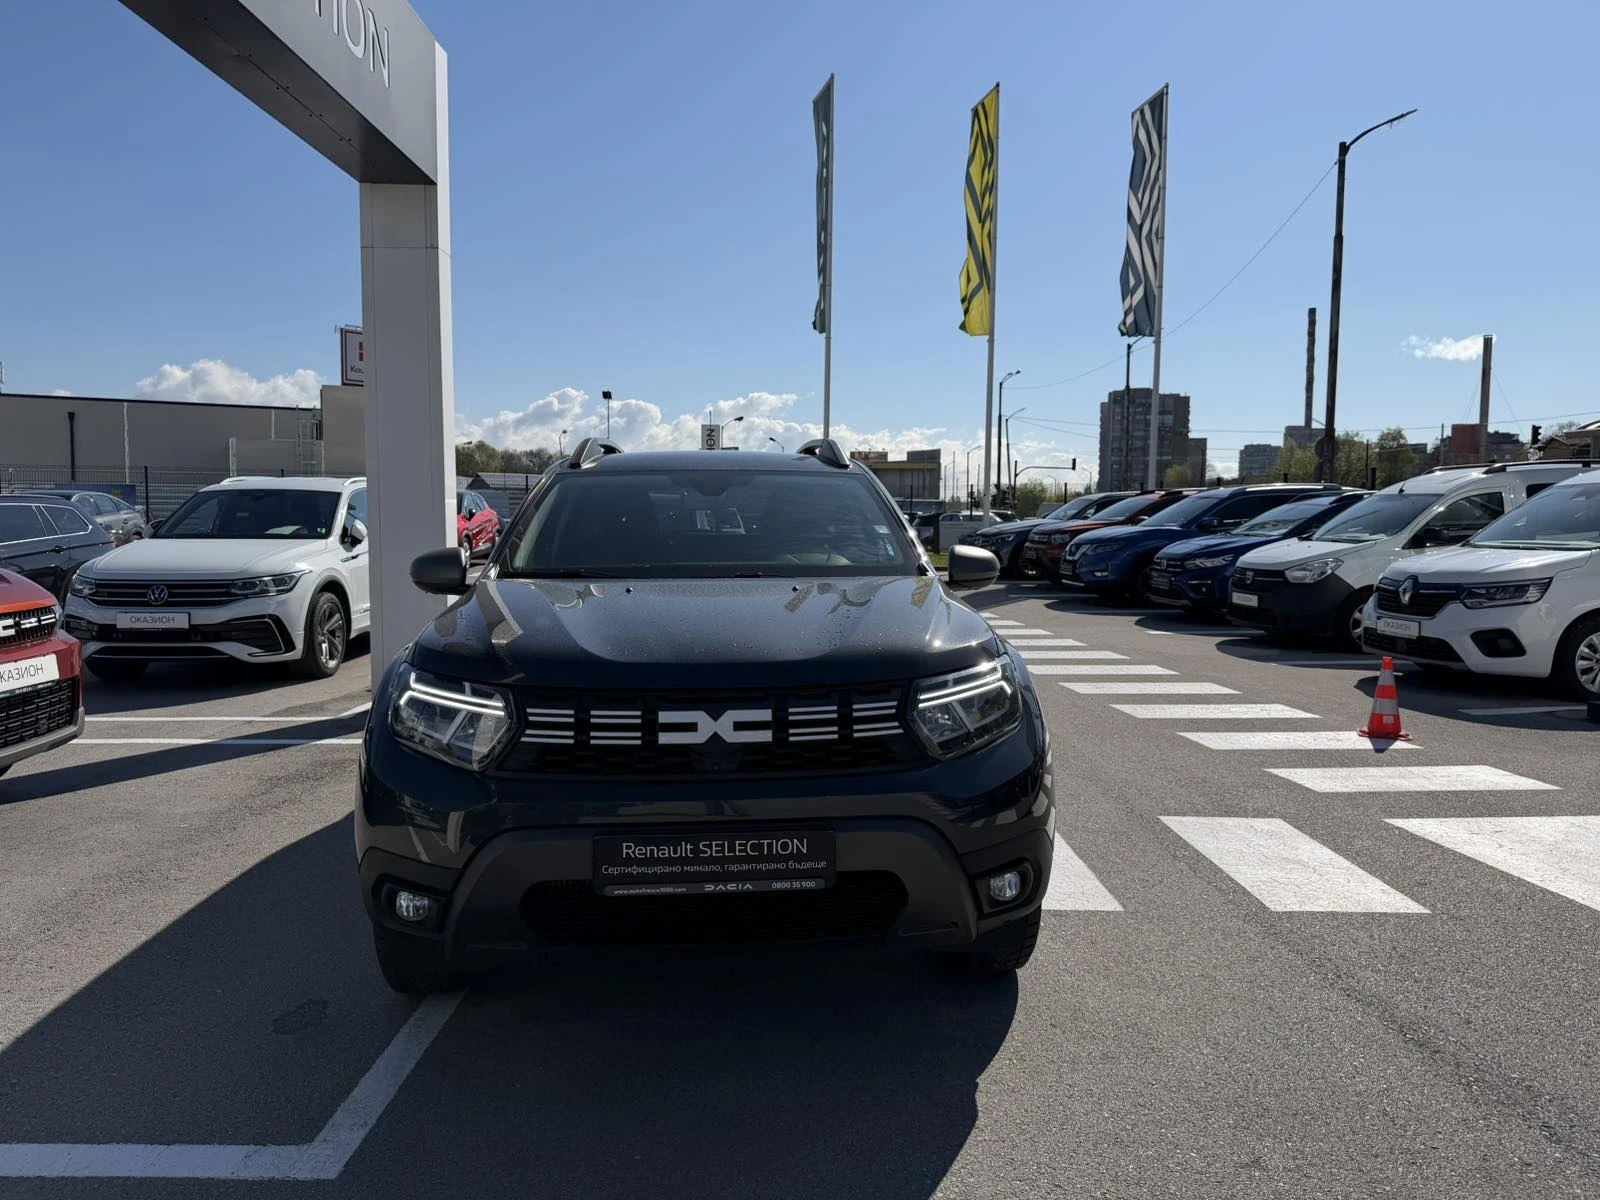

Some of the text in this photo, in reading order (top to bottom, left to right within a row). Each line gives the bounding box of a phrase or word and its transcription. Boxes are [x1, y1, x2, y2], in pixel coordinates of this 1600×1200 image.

[315, 0, 391, 89] ION
[129, 616, 175, 624] ОКАЗИОН
[622, 838, 807, 858] Renault SELECTION
[601, 860, 828, 876] Сертифицирано минало, гарантирано бъдеще
[703, 883, 753, 891] DACIA
